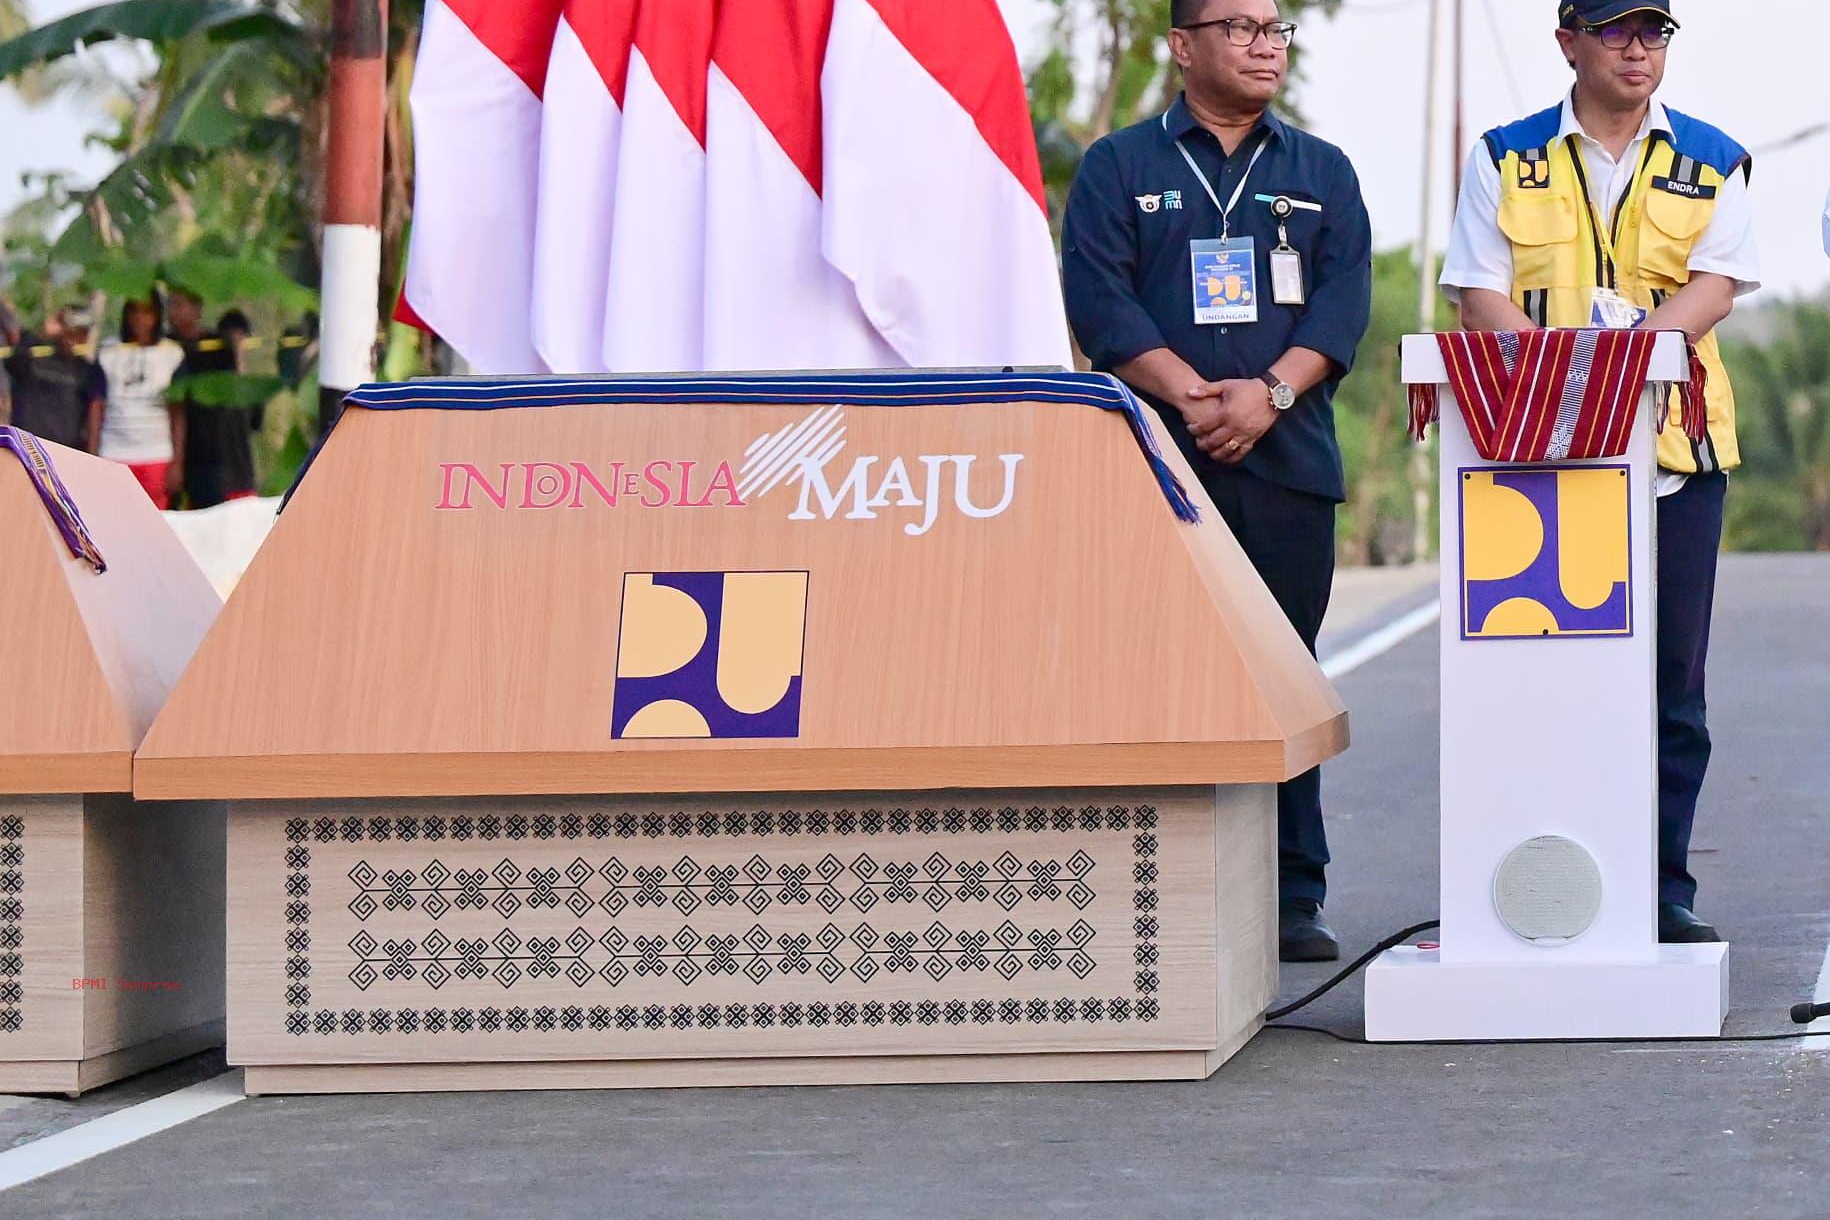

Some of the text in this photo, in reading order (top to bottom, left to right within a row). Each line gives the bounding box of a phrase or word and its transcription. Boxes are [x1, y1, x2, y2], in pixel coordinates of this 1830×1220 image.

[1667, 180, 1700, 196] ENDRA
[1202, 313, 1249, 321] UNDANGAN
[433, 452, 1025, 536] INDONESIA MAJU
